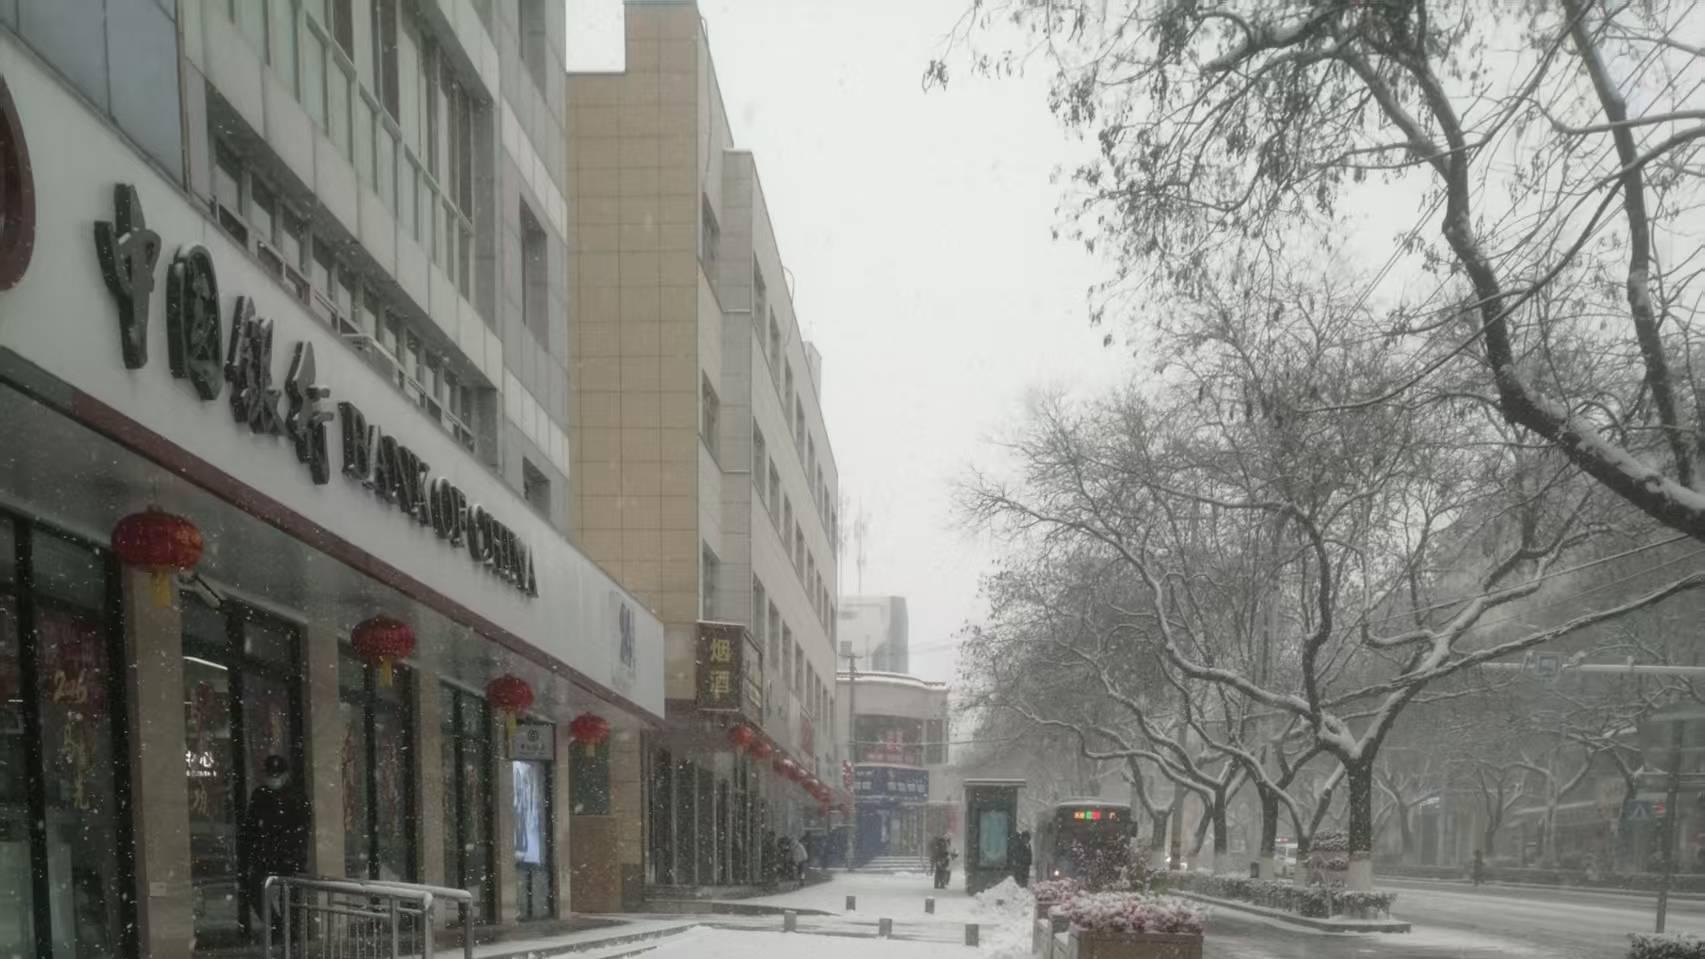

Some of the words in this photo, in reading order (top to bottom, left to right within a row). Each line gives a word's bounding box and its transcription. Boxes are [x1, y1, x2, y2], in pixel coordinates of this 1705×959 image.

[338, 401, 432, 527] BANK
[430, 476, 467, 548] OF
[466, 502, 539, 598] CHINA
[710, 638, 731, 698] 烟酒
